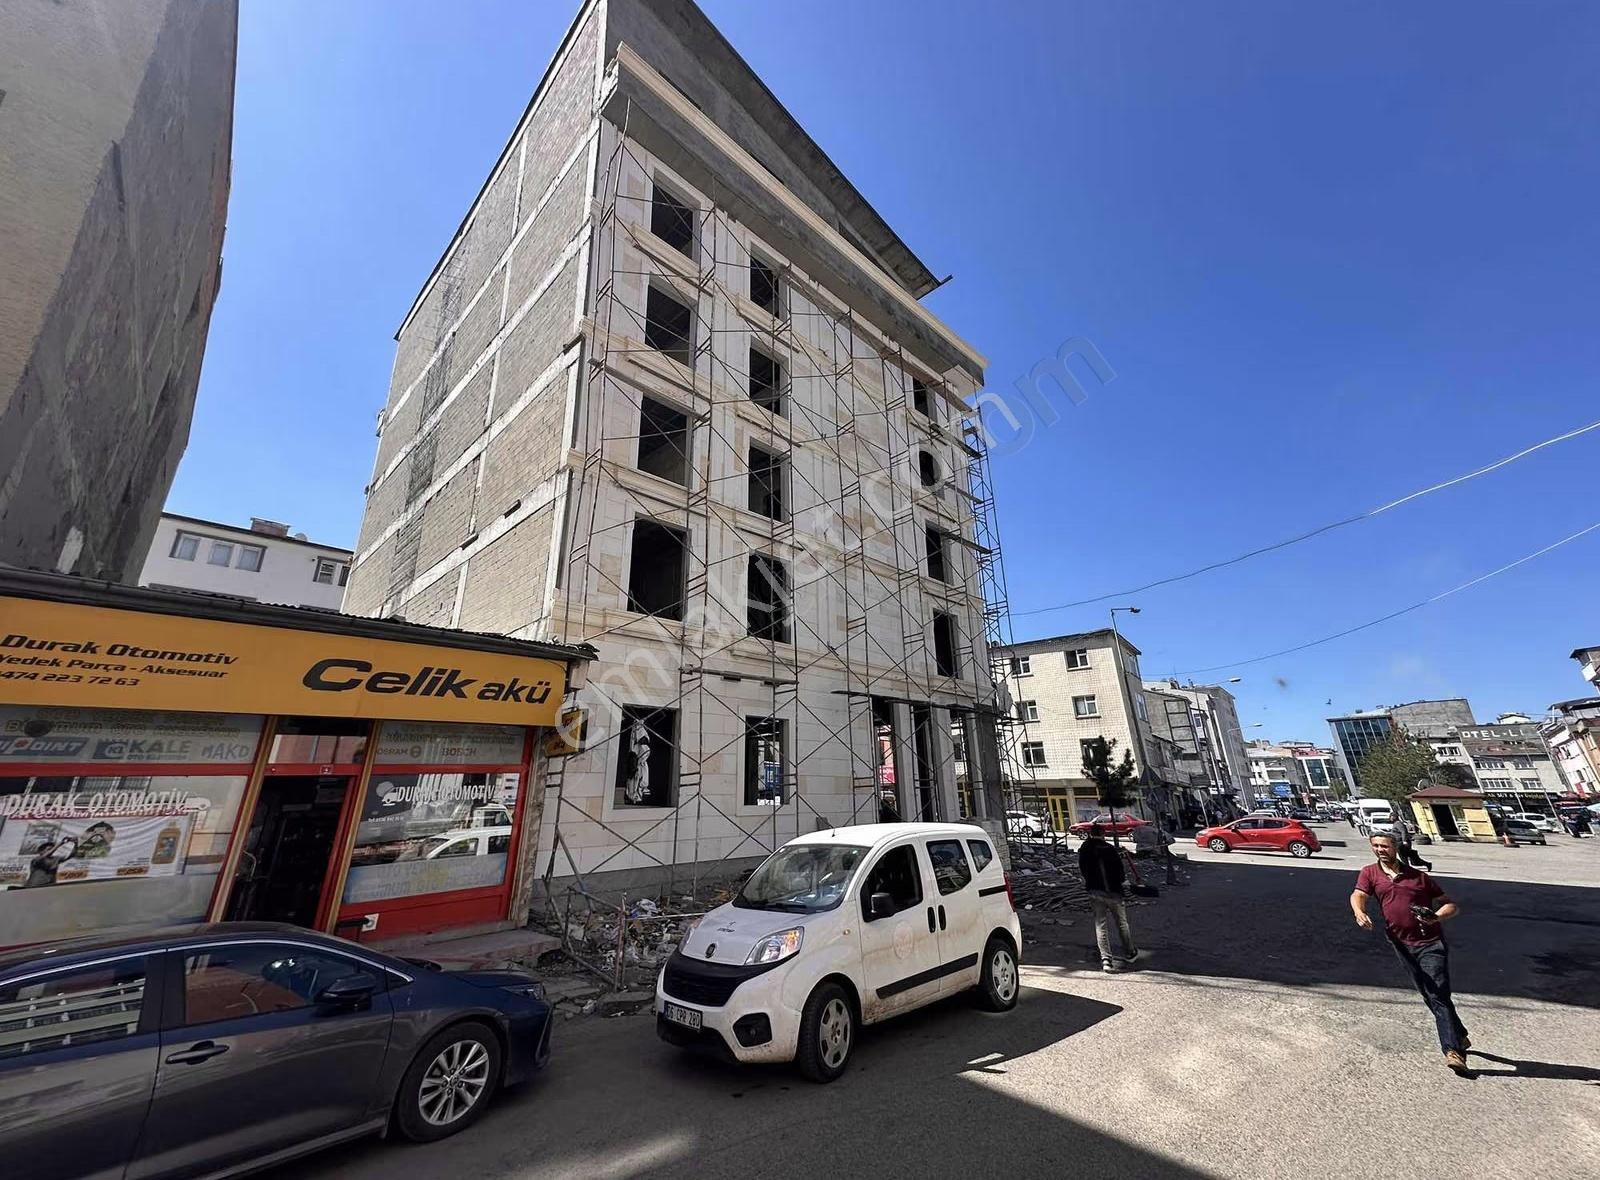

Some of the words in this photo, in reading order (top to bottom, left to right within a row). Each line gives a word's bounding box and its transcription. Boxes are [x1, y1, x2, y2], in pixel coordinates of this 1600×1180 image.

[1, 634, 101, 655] Durak
[106, 643, 239, 665] Otomotiv
[0, 670, 39, 680] 474
[42, 673, 82, 684] 223
[87, 675, 112, 686] 72
[114, 677, 141, 687] 63
[67, 659, 125, 673] Parça
[141, 665, 229, 679] Aksesuar
[477, 678, 552, 705] akü
[128, 739, 192, 753] KALE
